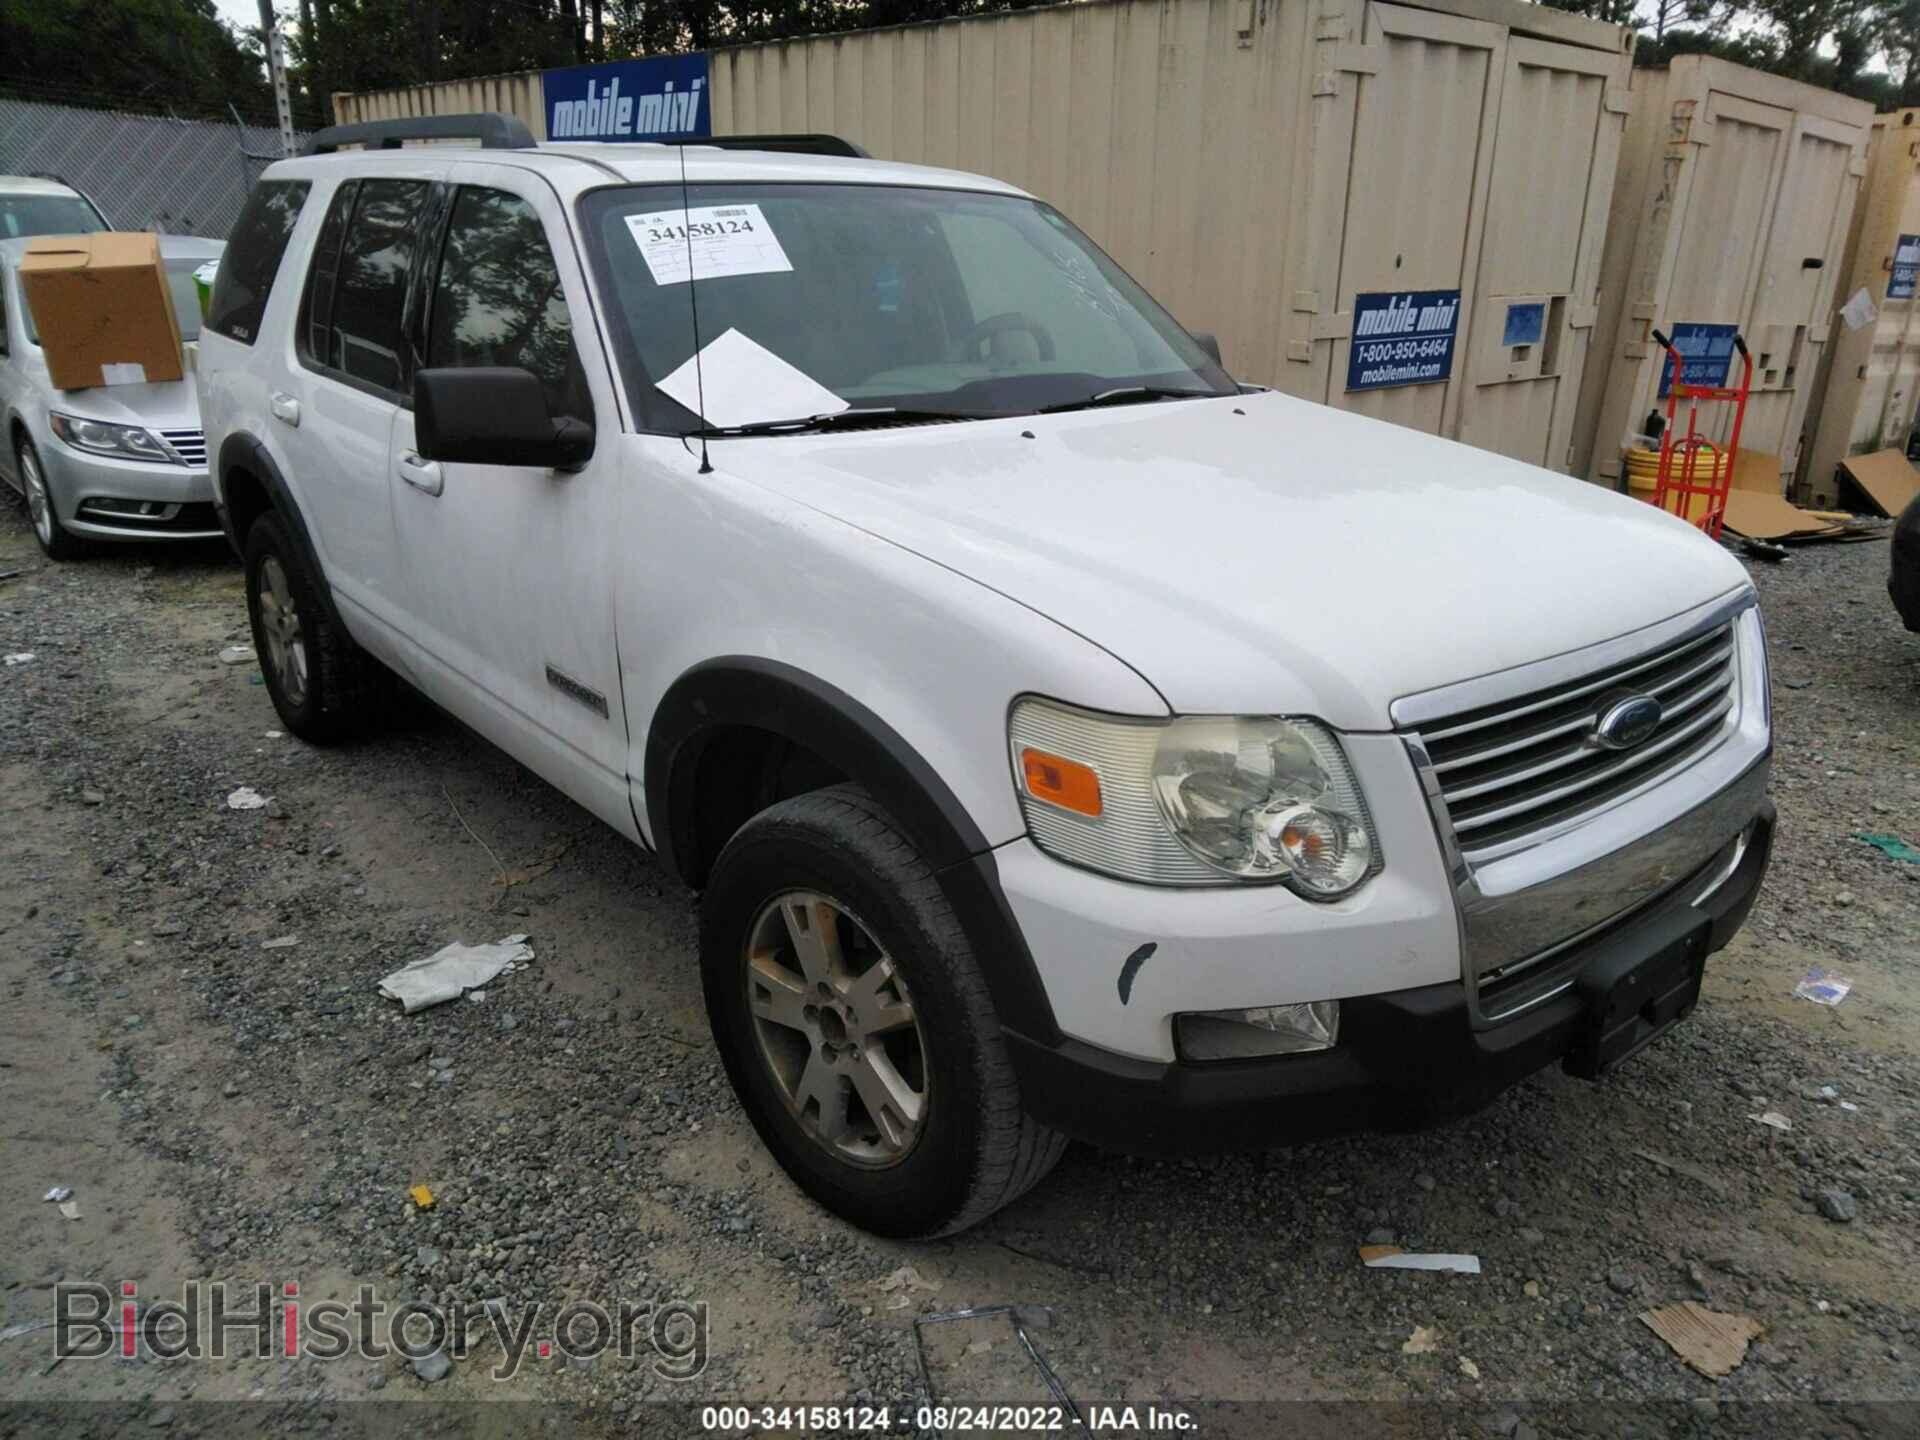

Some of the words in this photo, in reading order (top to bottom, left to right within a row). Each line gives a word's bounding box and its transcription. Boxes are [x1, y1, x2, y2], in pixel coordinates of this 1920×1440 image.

[553, 77, 632, 137] mobile
[636, 79, 701, 133] mini
[648, 219, 754, 243] 34158124
[1356, 295, 1418, 336] mobile
[1416, 298, 1457, 332] mini
[1357, 338, 1448, 363] 1-800-950-6464
[1360, 362, 1440, 384] mobilemini.com
